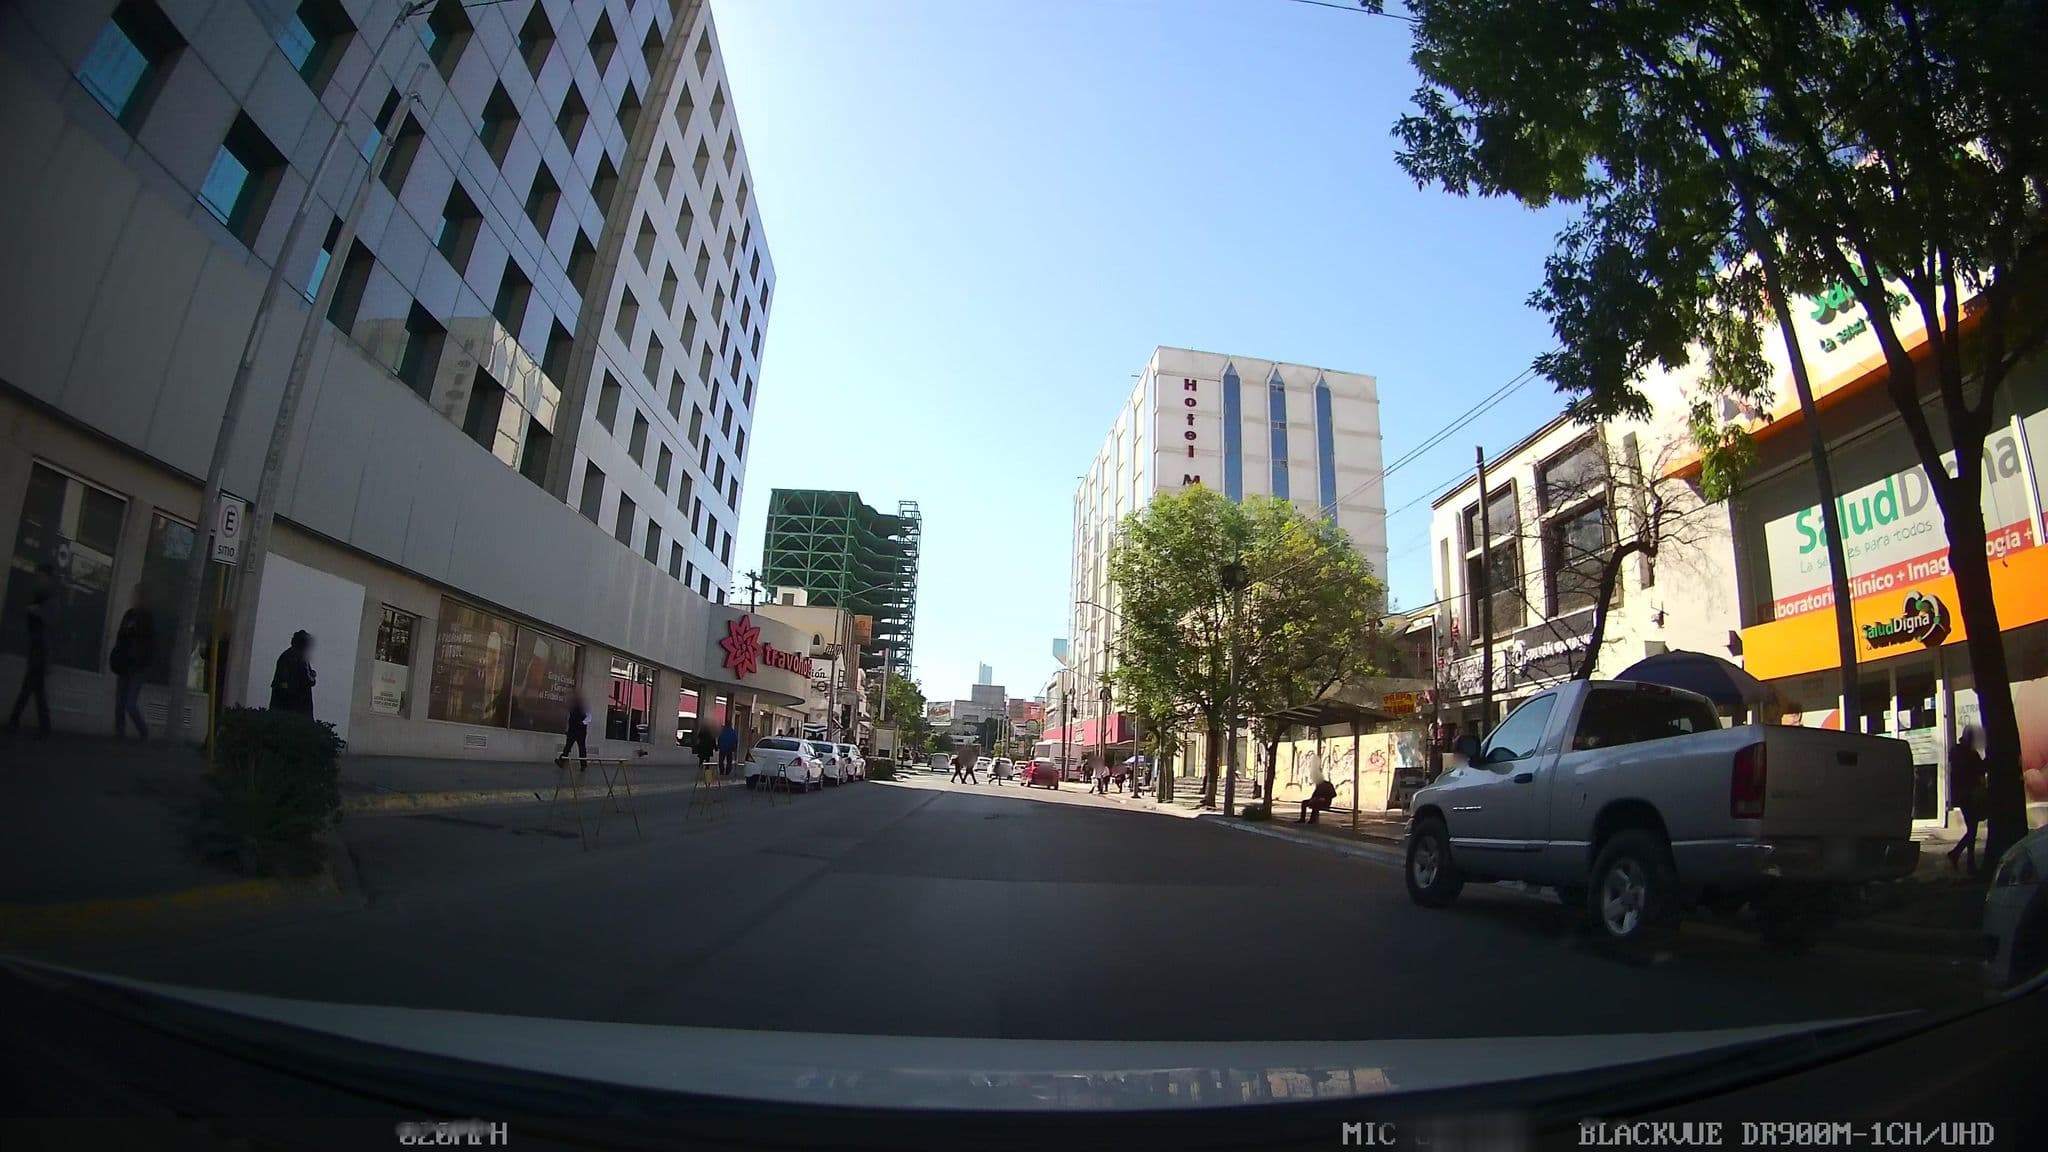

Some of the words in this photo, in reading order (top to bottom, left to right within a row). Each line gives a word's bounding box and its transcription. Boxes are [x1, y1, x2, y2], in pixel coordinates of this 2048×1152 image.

[1184, 379, 1197, 458] Hotel
[225, 511, 235, 531] E
[218, 544, 235, 557] SITIO
[1801, 559, 1814, 574] La
[1847, 547, 1861, 559] es
[1865, 535, 1890, 554] para
[1893, 519, 1933, 542] todos
[1774, 586, 1834, 620] boratori
